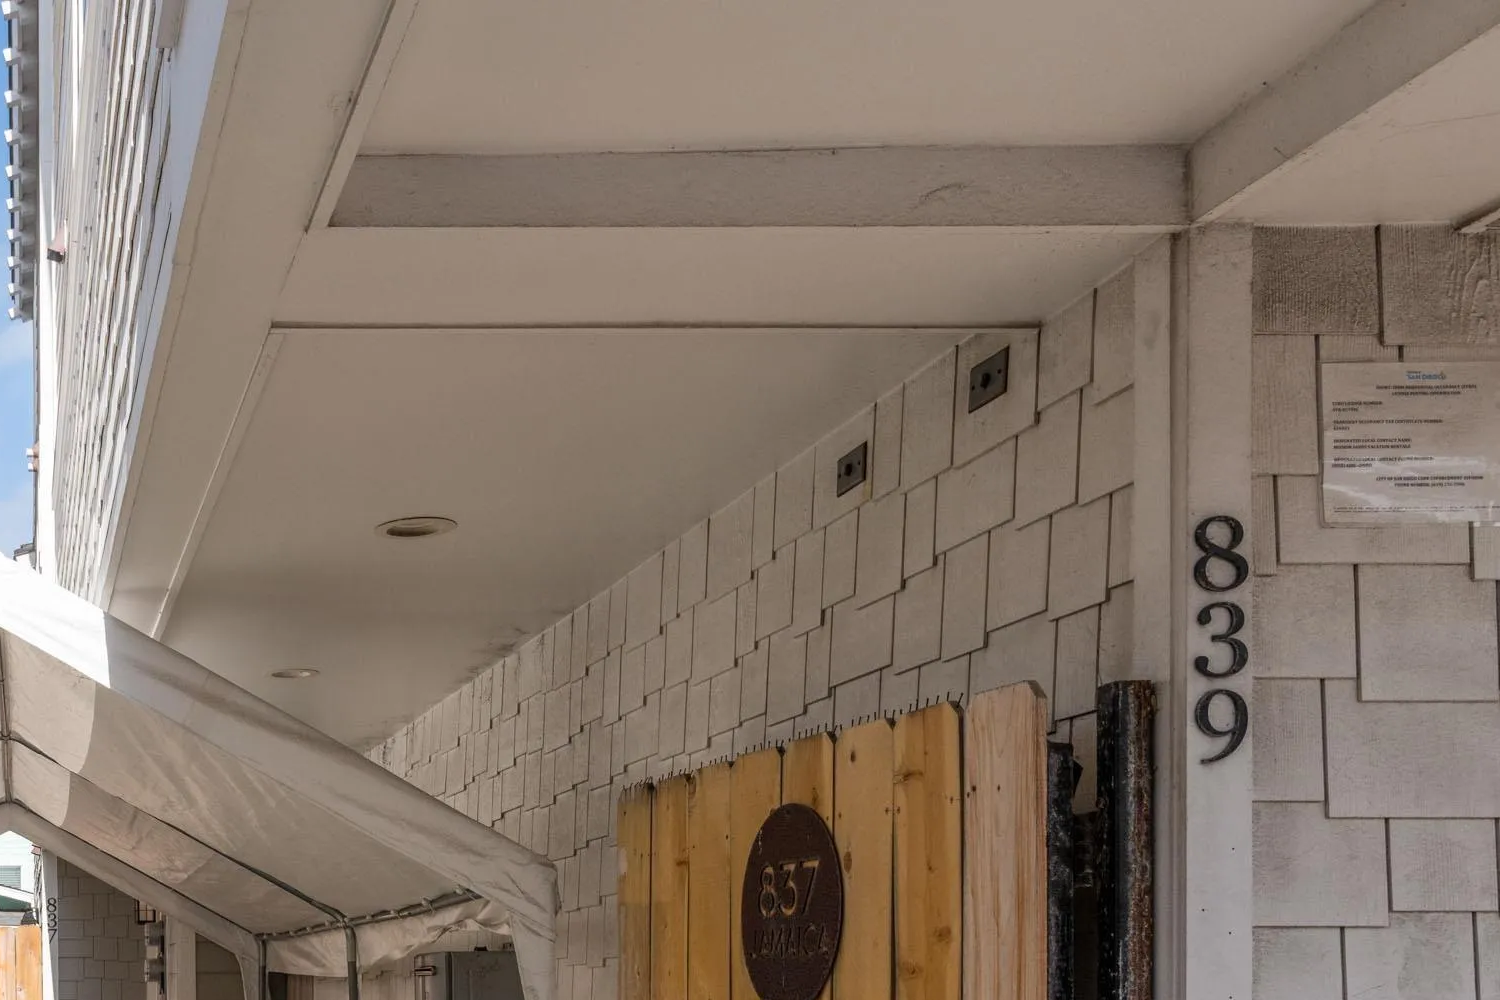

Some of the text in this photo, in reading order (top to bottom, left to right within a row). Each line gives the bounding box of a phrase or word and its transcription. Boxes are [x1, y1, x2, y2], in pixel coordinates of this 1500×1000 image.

[1193, 515, 1249, 765] 839
[758, 858, 820, 919] 837
[47, 897, 57, 944] 837
